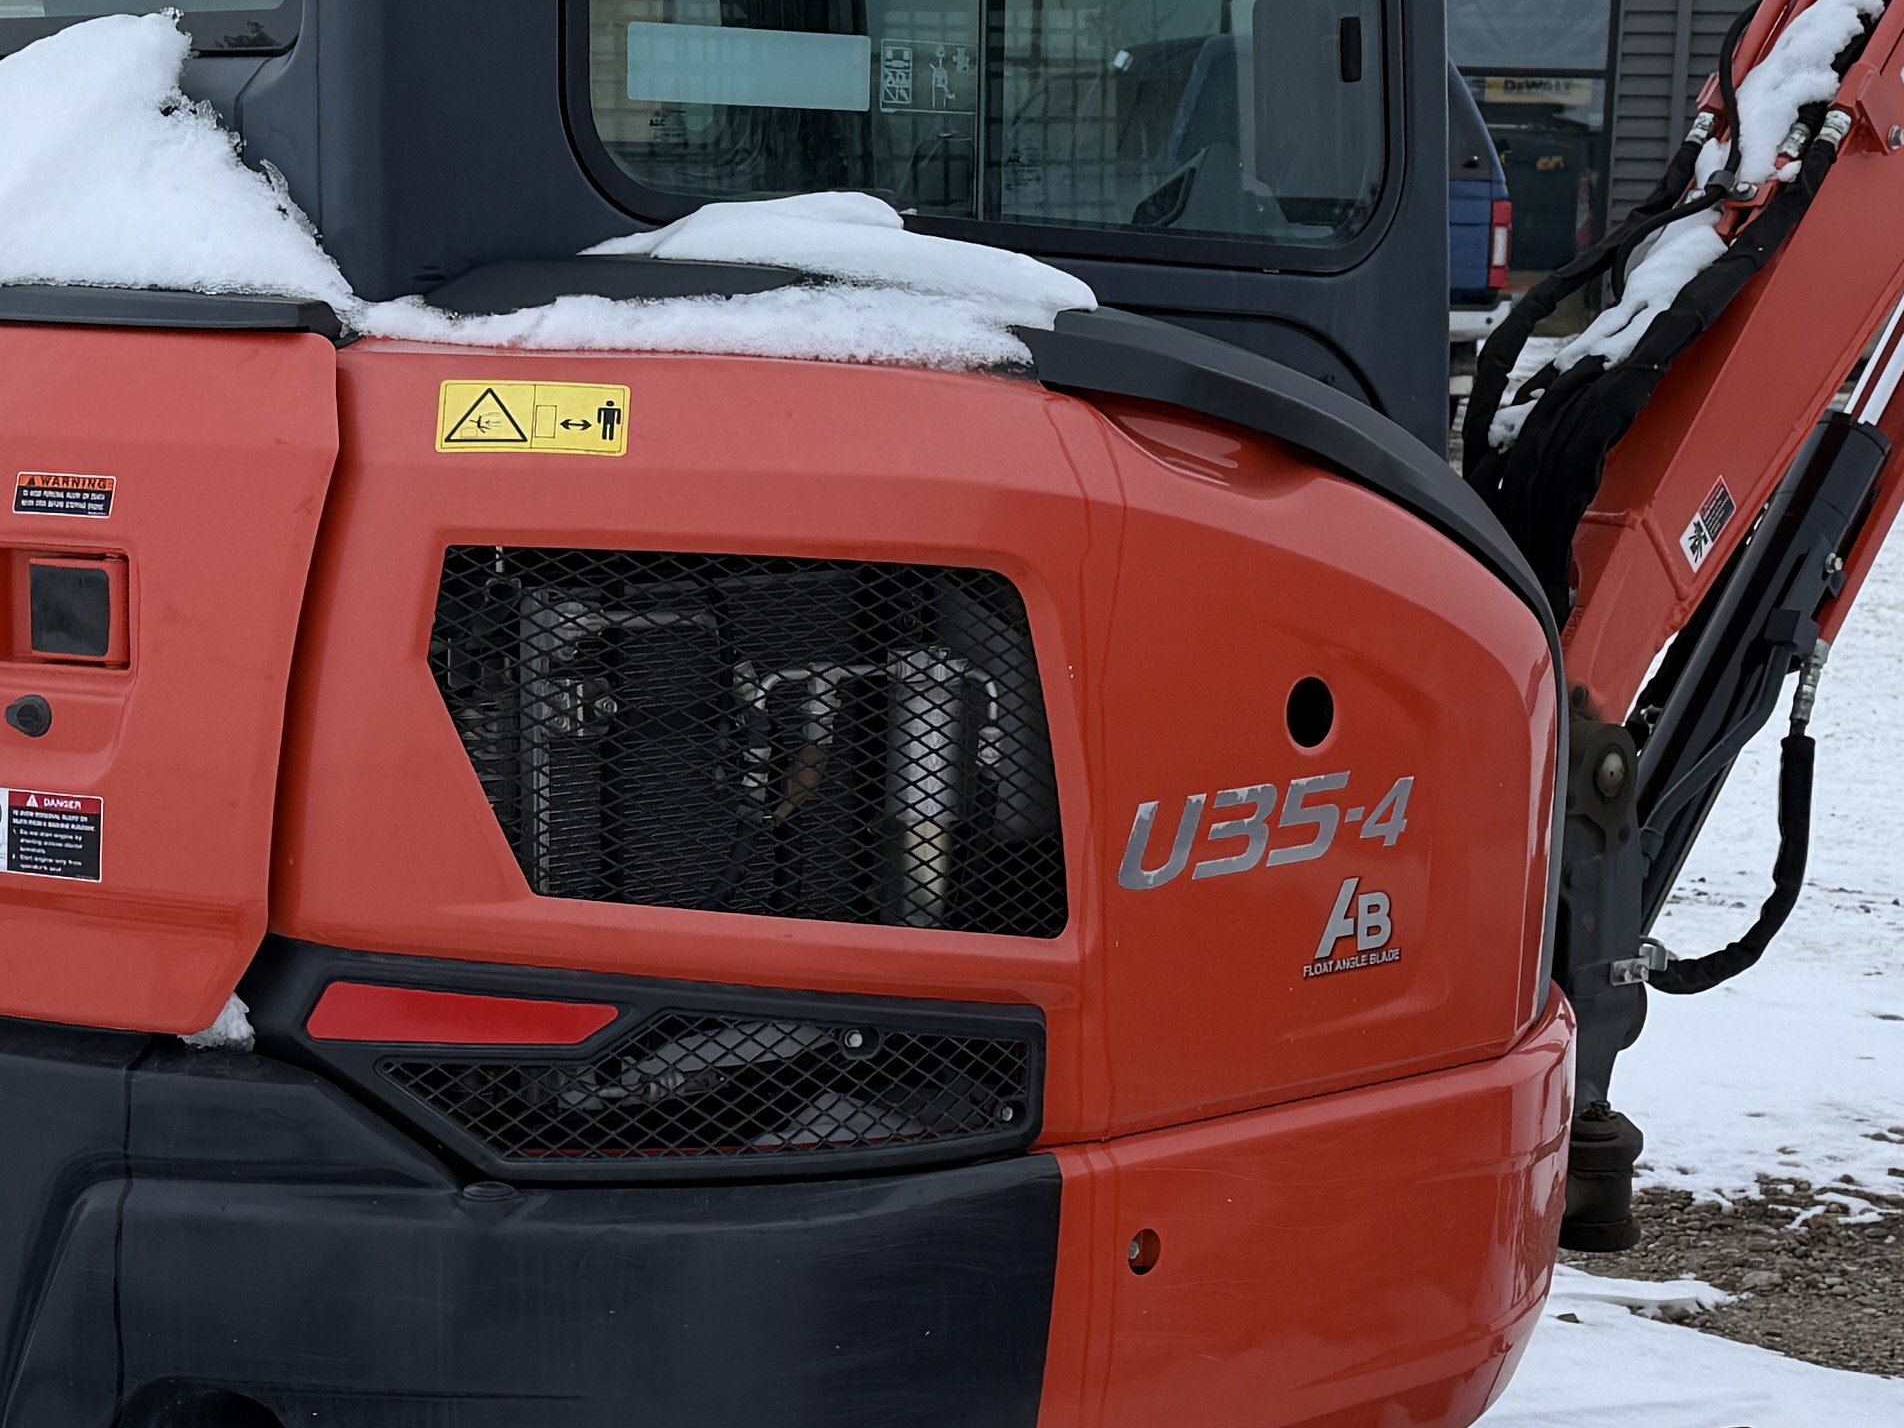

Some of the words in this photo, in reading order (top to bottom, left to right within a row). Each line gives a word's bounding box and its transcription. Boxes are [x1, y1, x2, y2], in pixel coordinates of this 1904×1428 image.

[41, 476, 107, 490] WARNING
[43, 797, 82, 810] DANGER
[1117, 770, 1415, 891] U35-4
[1302, 959, 1334, 978] FLOAT
[1335, 955, 1368, 971] ANGLE
[1369, 949, 1401, 965] BLADE
